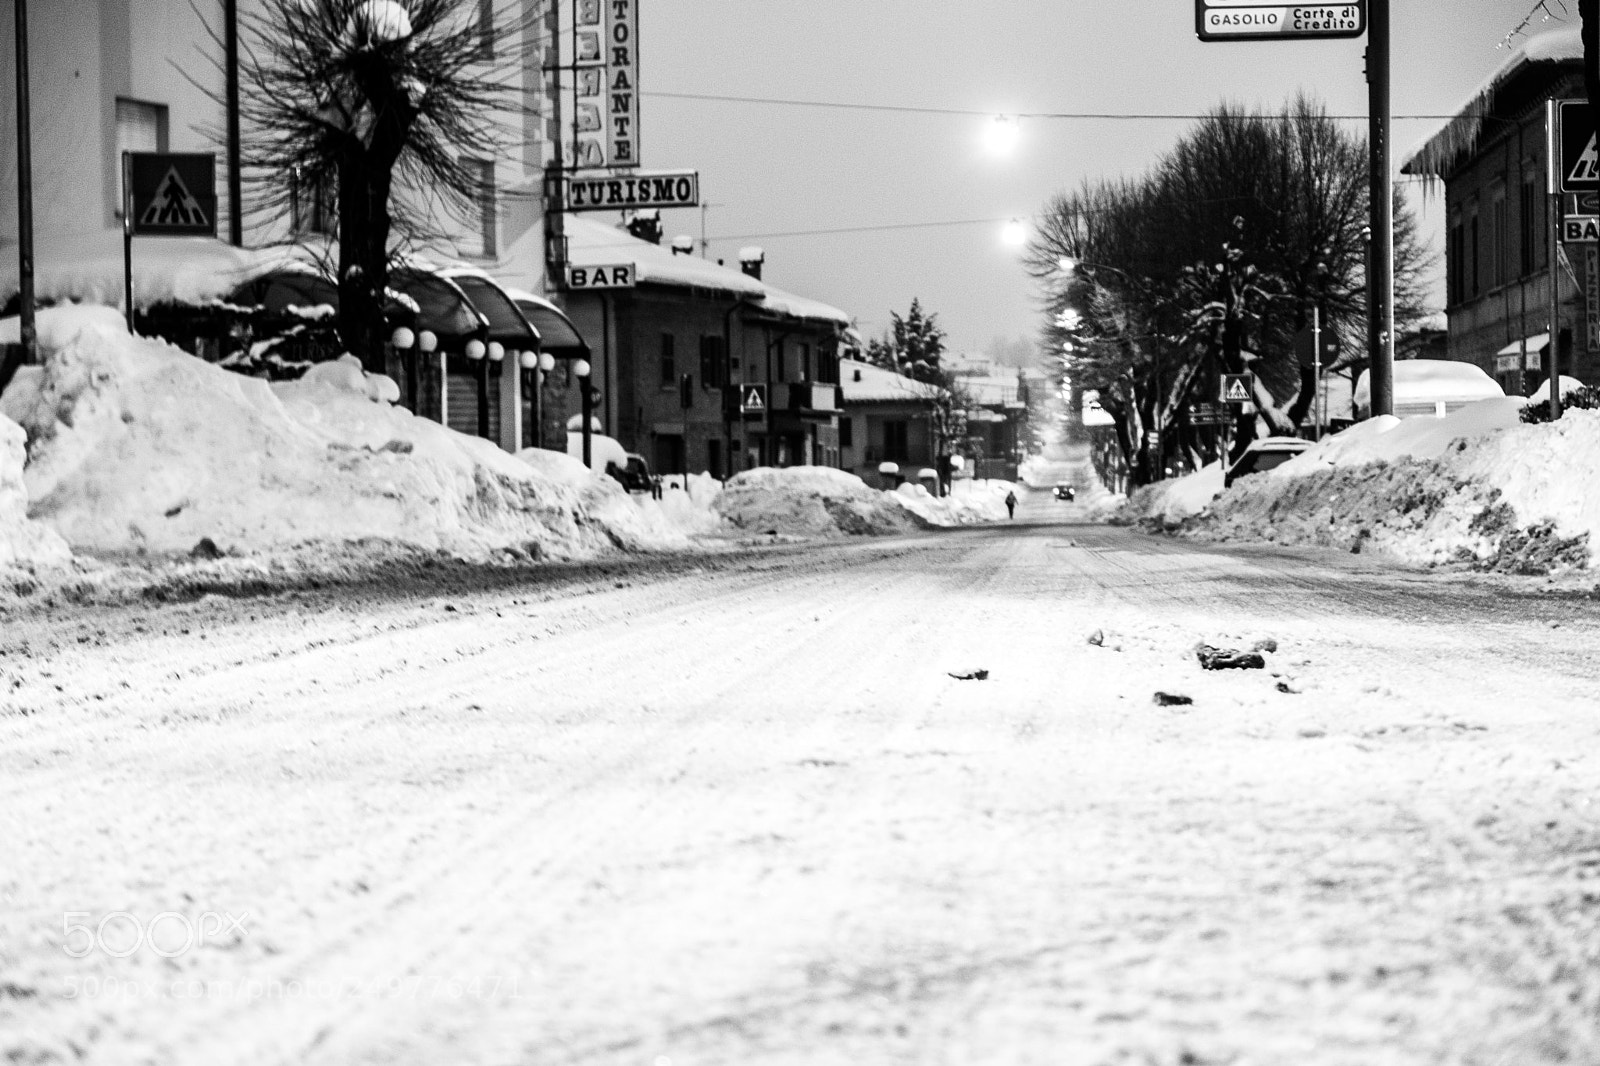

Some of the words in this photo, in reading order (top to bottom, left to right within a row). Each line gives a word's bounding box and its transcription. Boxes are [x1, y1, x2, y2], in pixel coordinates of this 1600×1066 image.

[1211, 13, 1278, 26] GASOLIO
[1293, 8, 1334, 19] Carte
[1342, 6, 1355, 18] di
[1293, 18, 1355, 29] Credito
[611, 0, 633, 161] TORANTE
[571, 177, 691, 205] TURISMO
[570, 266, 630, 287] BAR
[1587, 250, 1598, 349] PIZZERIA
